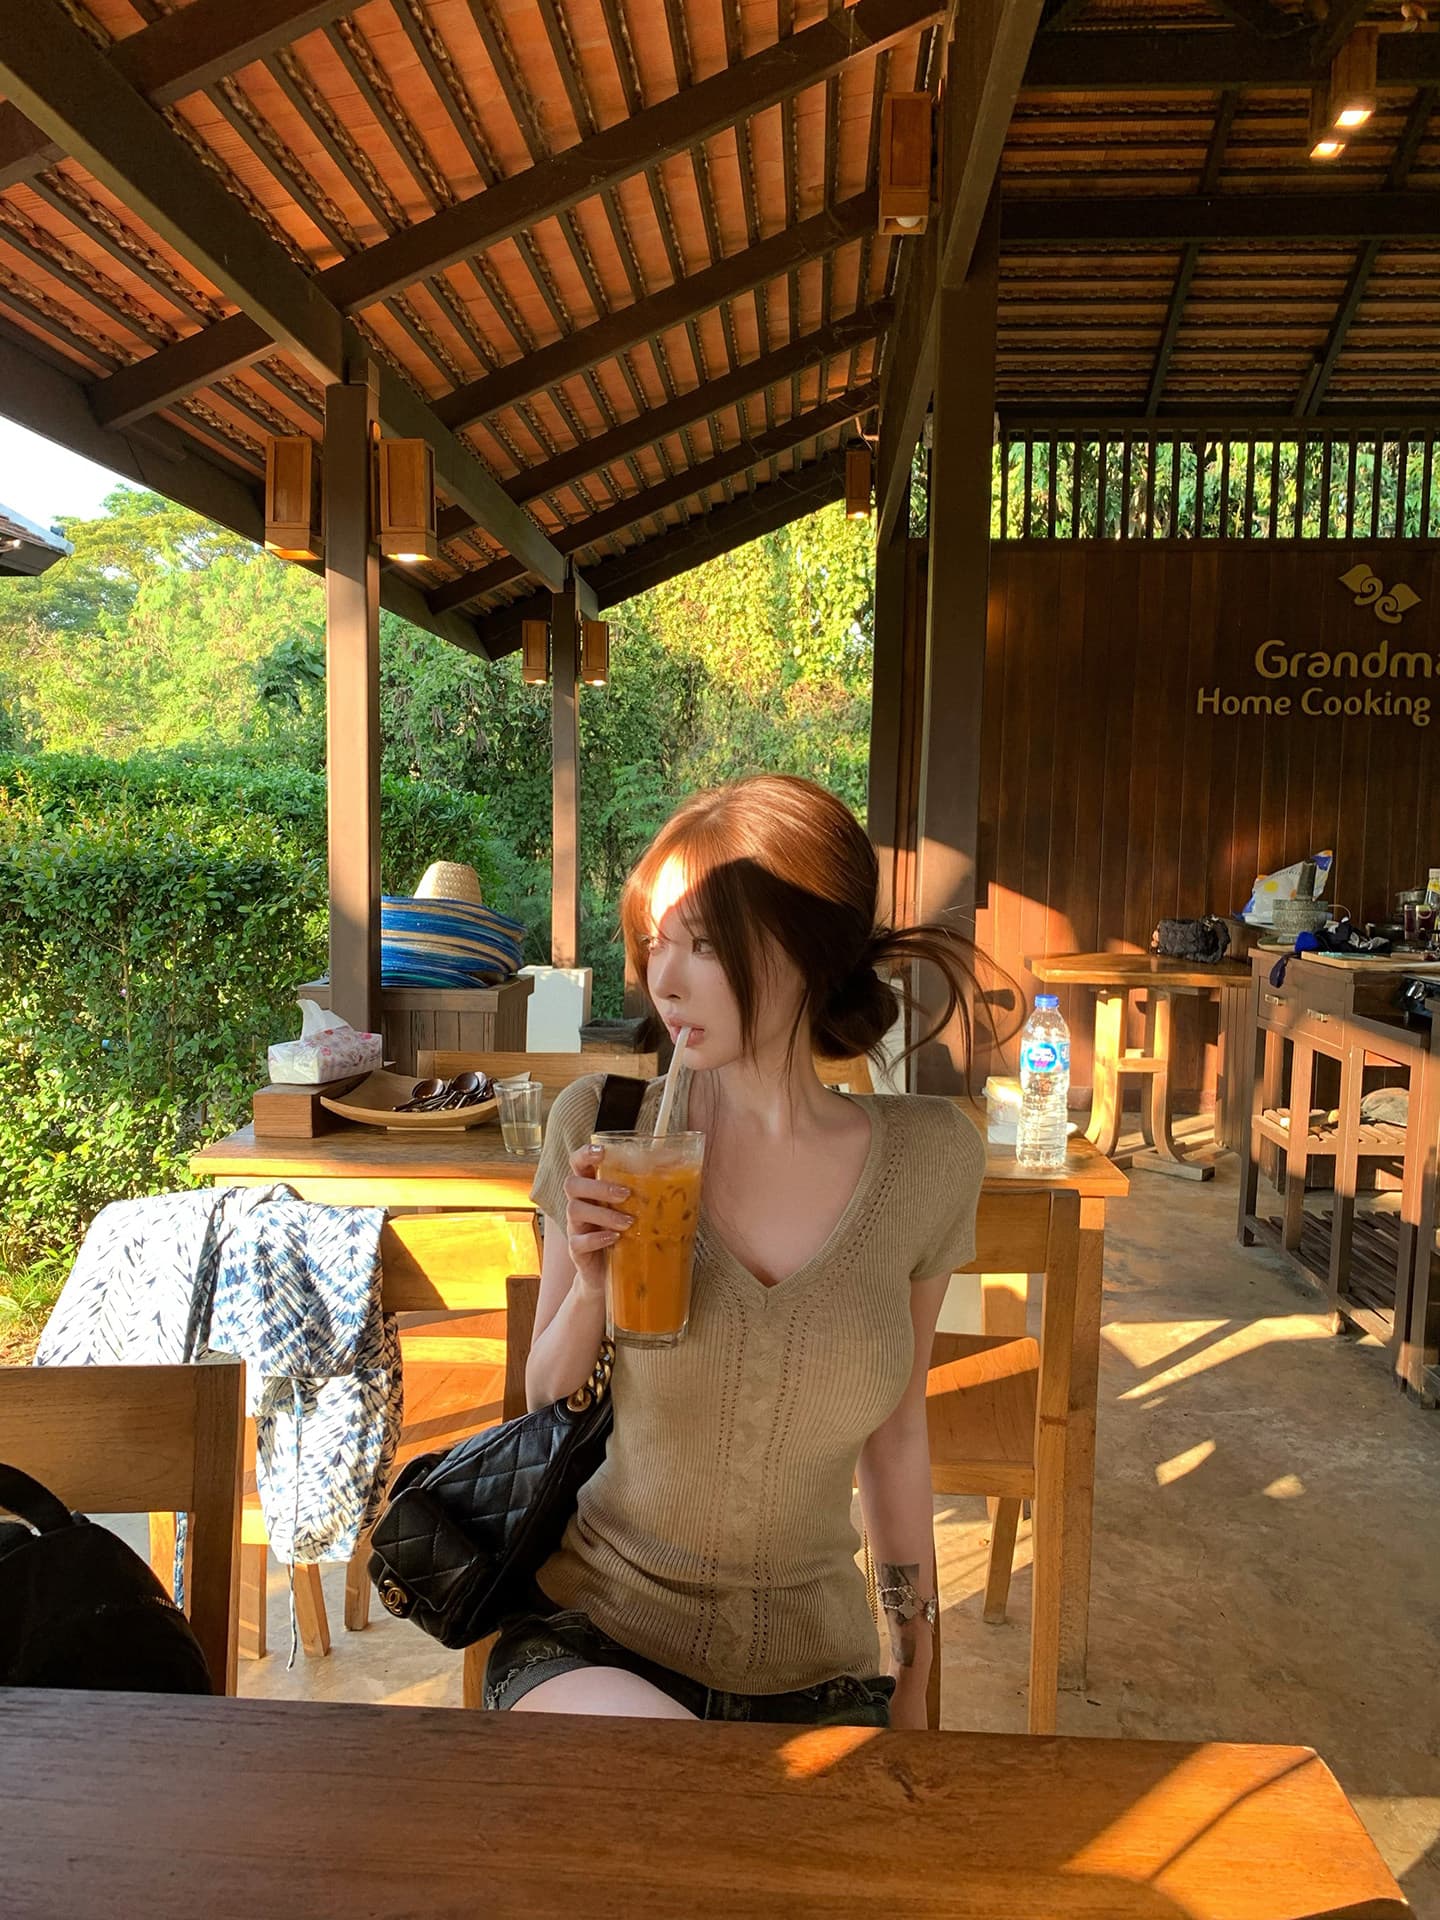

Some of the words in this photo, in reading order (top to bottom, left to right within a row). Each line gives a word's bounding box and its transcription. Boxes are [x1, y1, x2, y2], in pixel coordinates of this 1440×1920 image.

[1255, 639, 1440, 679] Grandm
[1196, 687, 1291, 716] Home
[1301, 687, 1431, 727] Cooking
